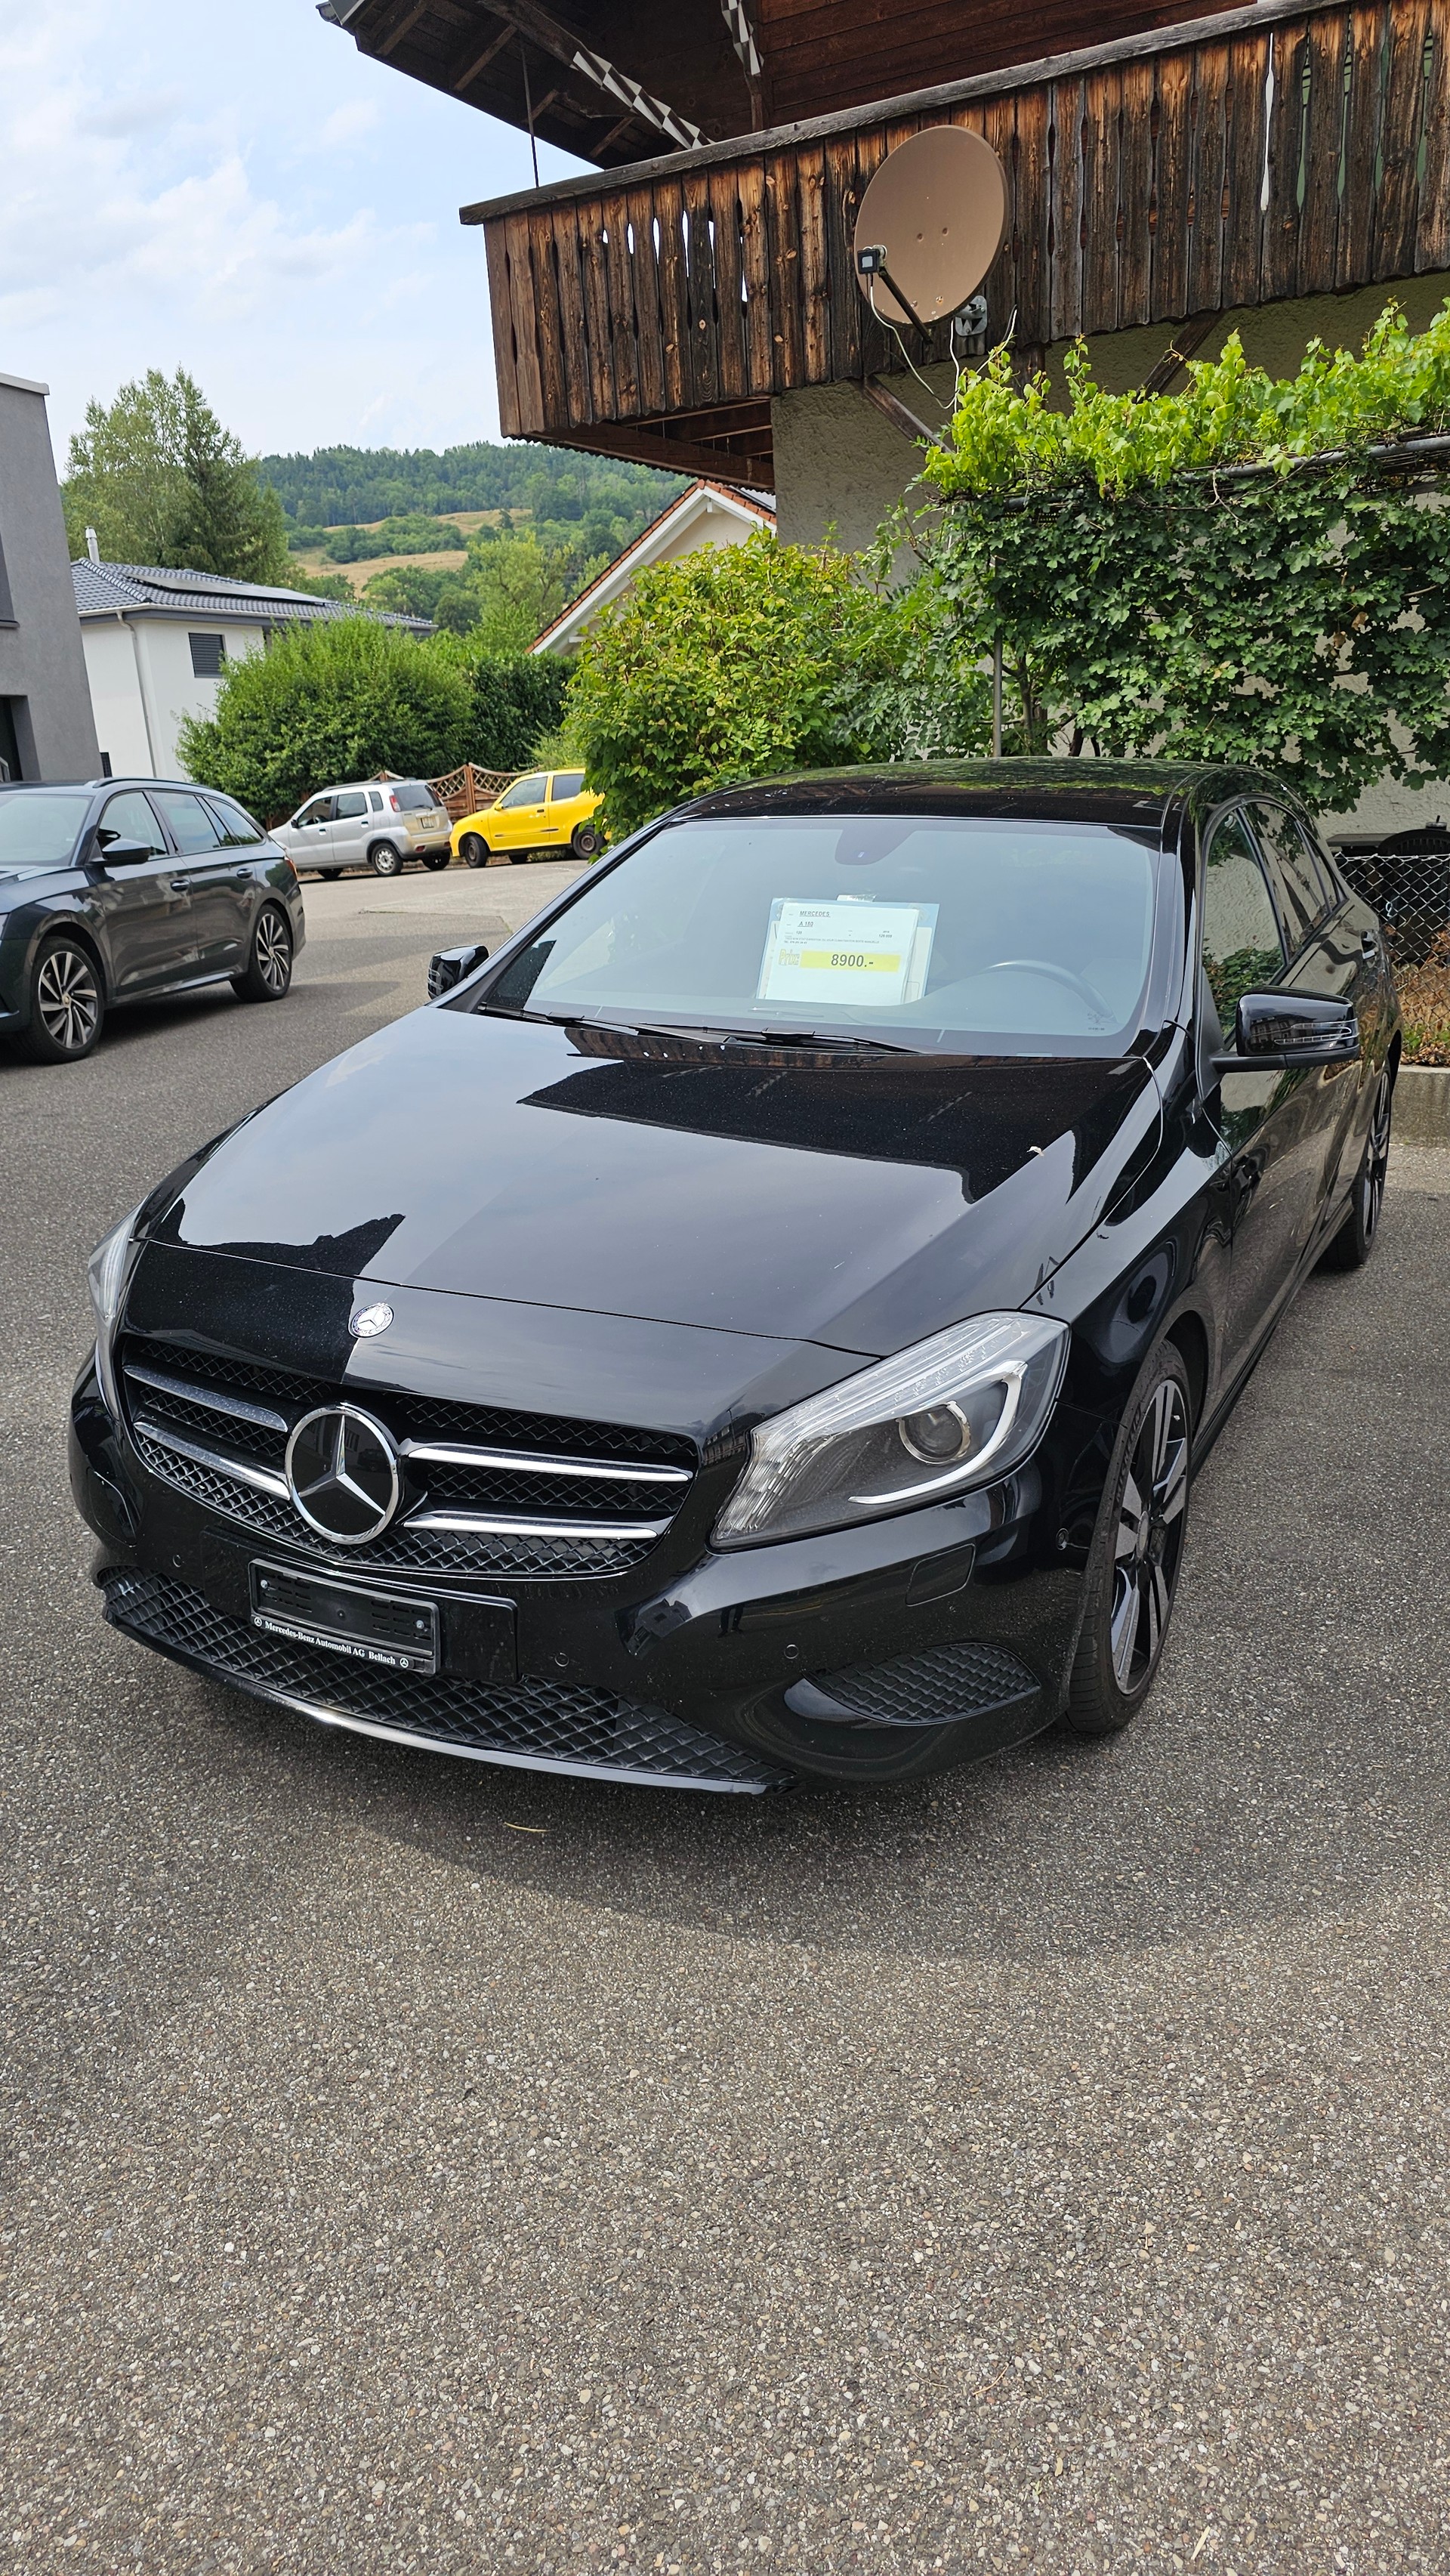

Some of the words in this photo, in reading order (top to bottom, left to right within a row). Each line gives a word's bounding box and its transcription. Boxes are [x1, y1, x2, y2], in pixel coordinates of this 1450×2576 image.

[831, 954, 874, 967] 8900.-
[264, 1620, 315, 1644] Mercedes-Benz
[315, 1636, 352, 1654] Automobil
[352, 1647, 366, 1657] AG
[369, 1651, 396, 1666] Bellach
